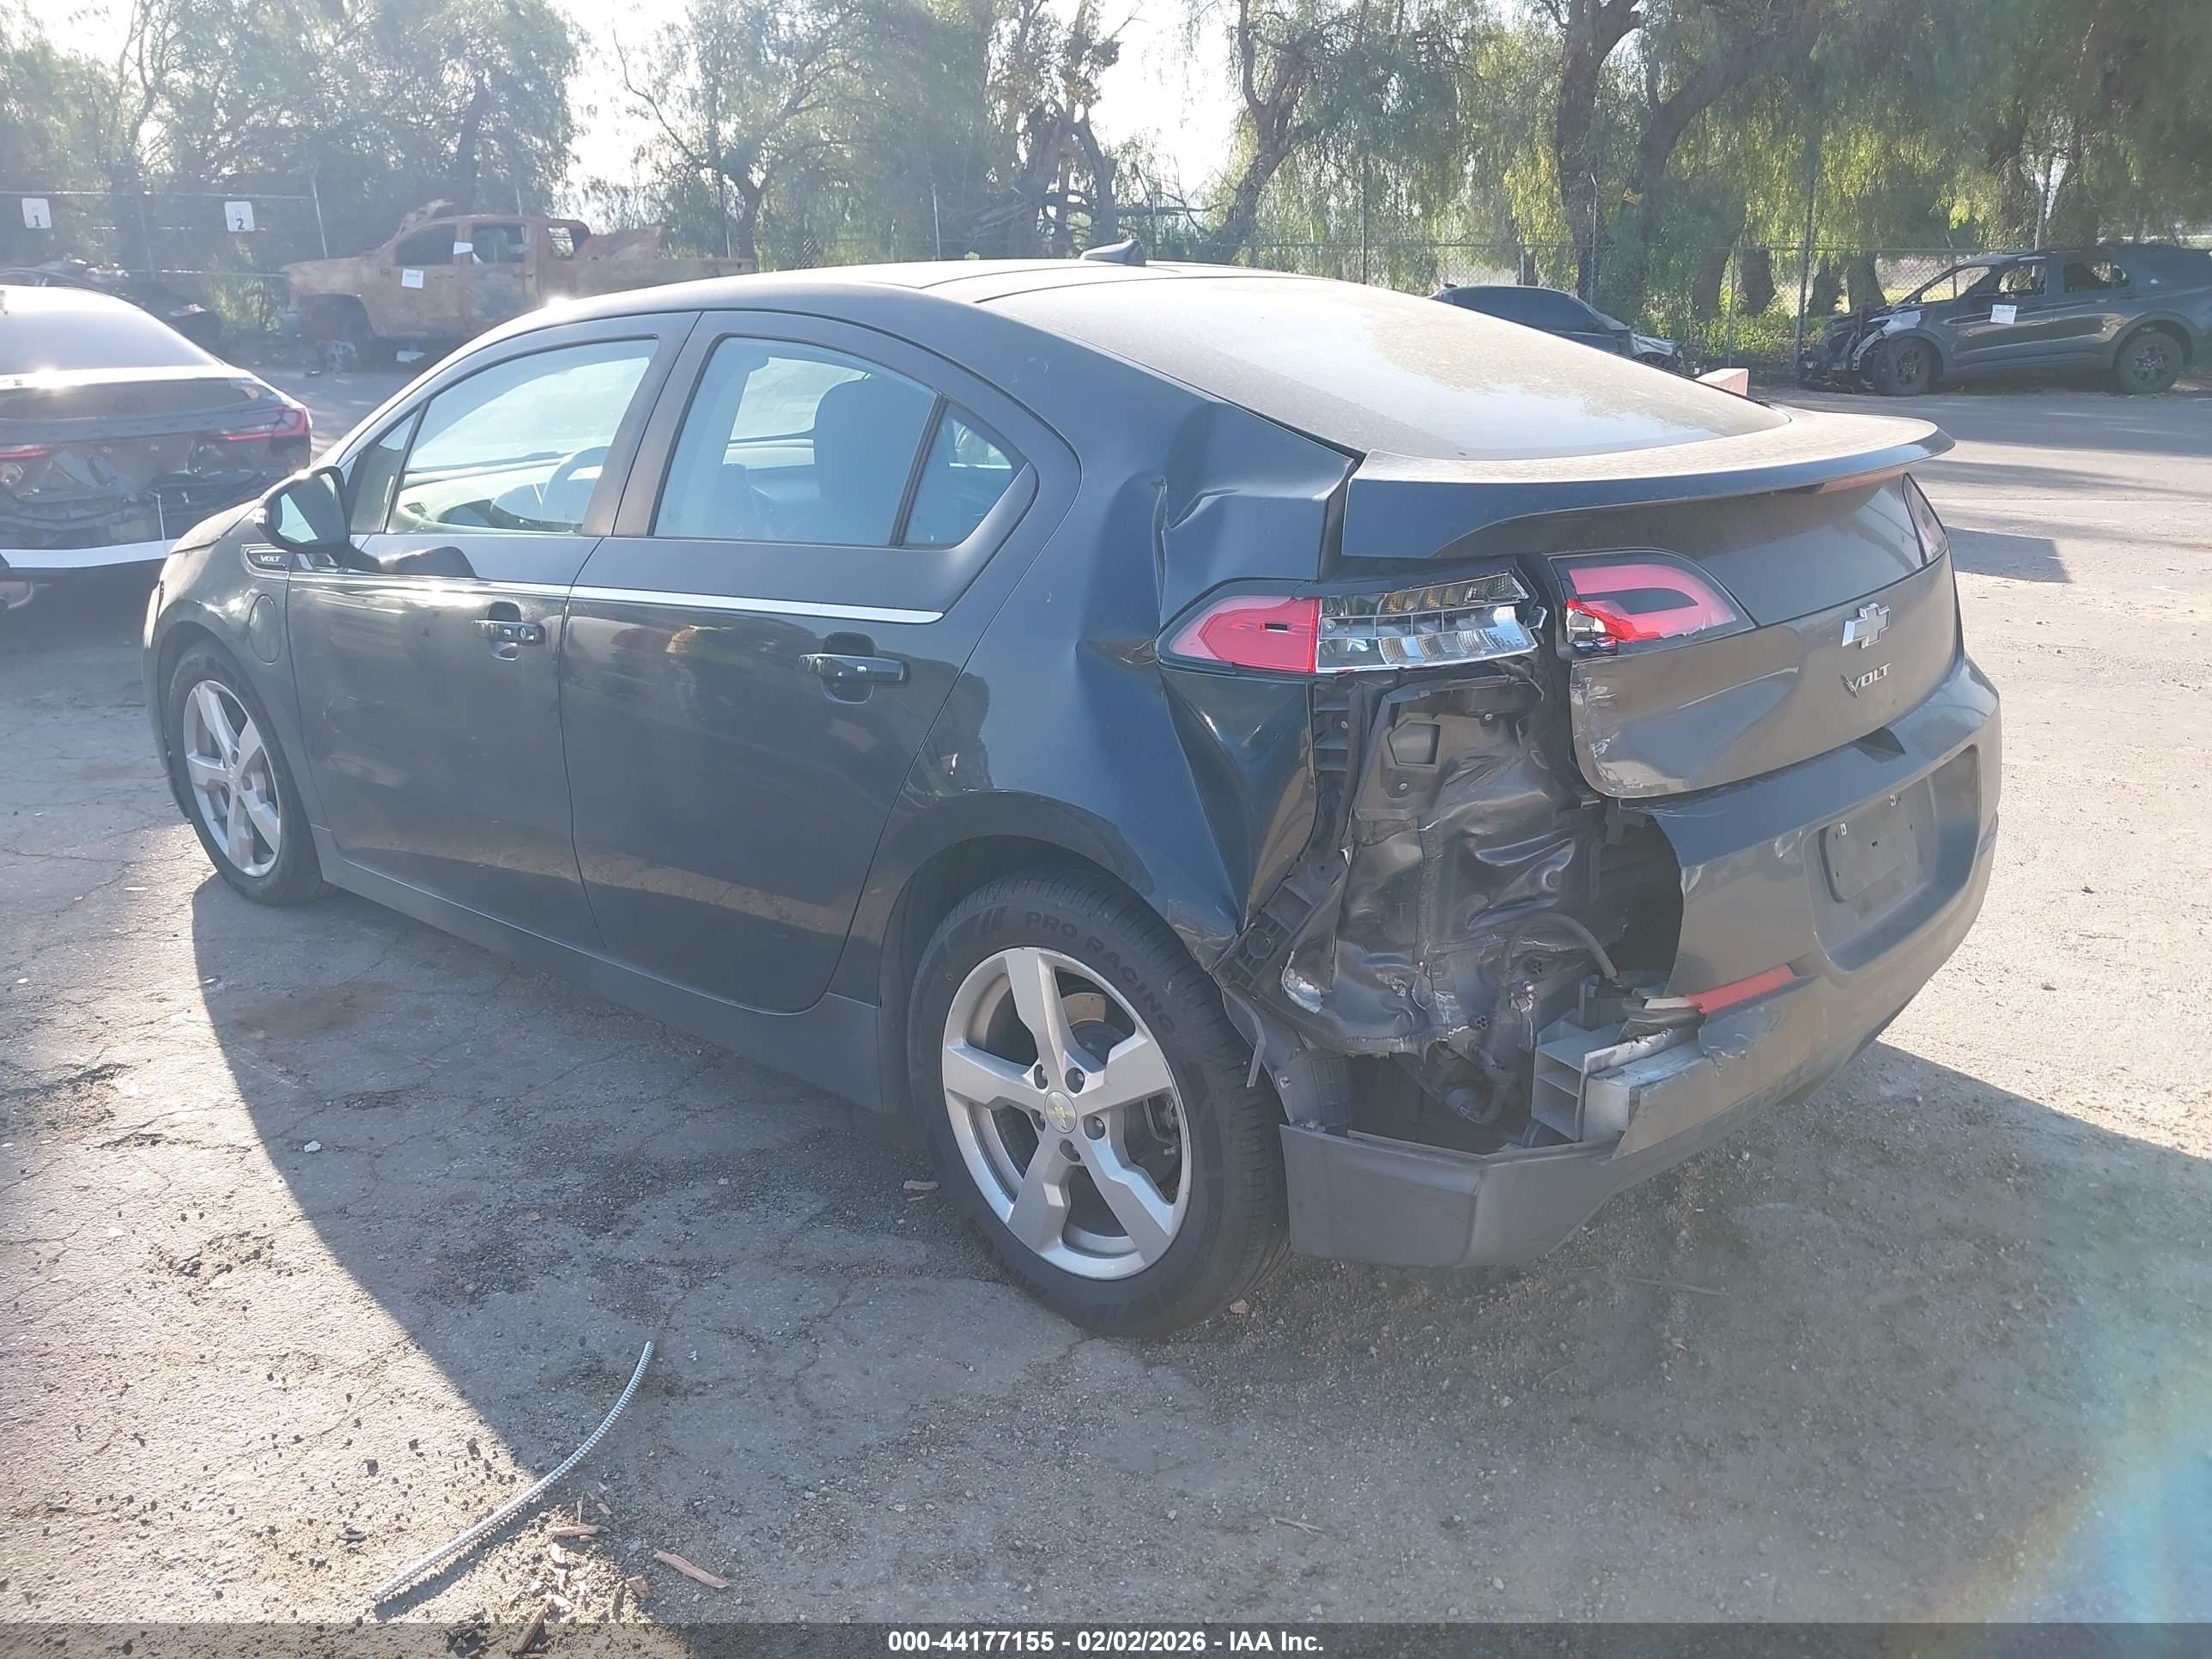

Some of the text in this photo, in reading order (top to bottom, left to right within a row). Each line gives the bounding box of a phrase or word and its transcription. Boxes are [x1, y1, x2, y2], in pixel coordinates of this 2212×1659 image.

[33, 215, 41, 228] 1
[236, 217, 246, 230] 2
[1840, 662, 1891, 699] VOLT
[1024, 910, 1176, 1034] PRO RACING
